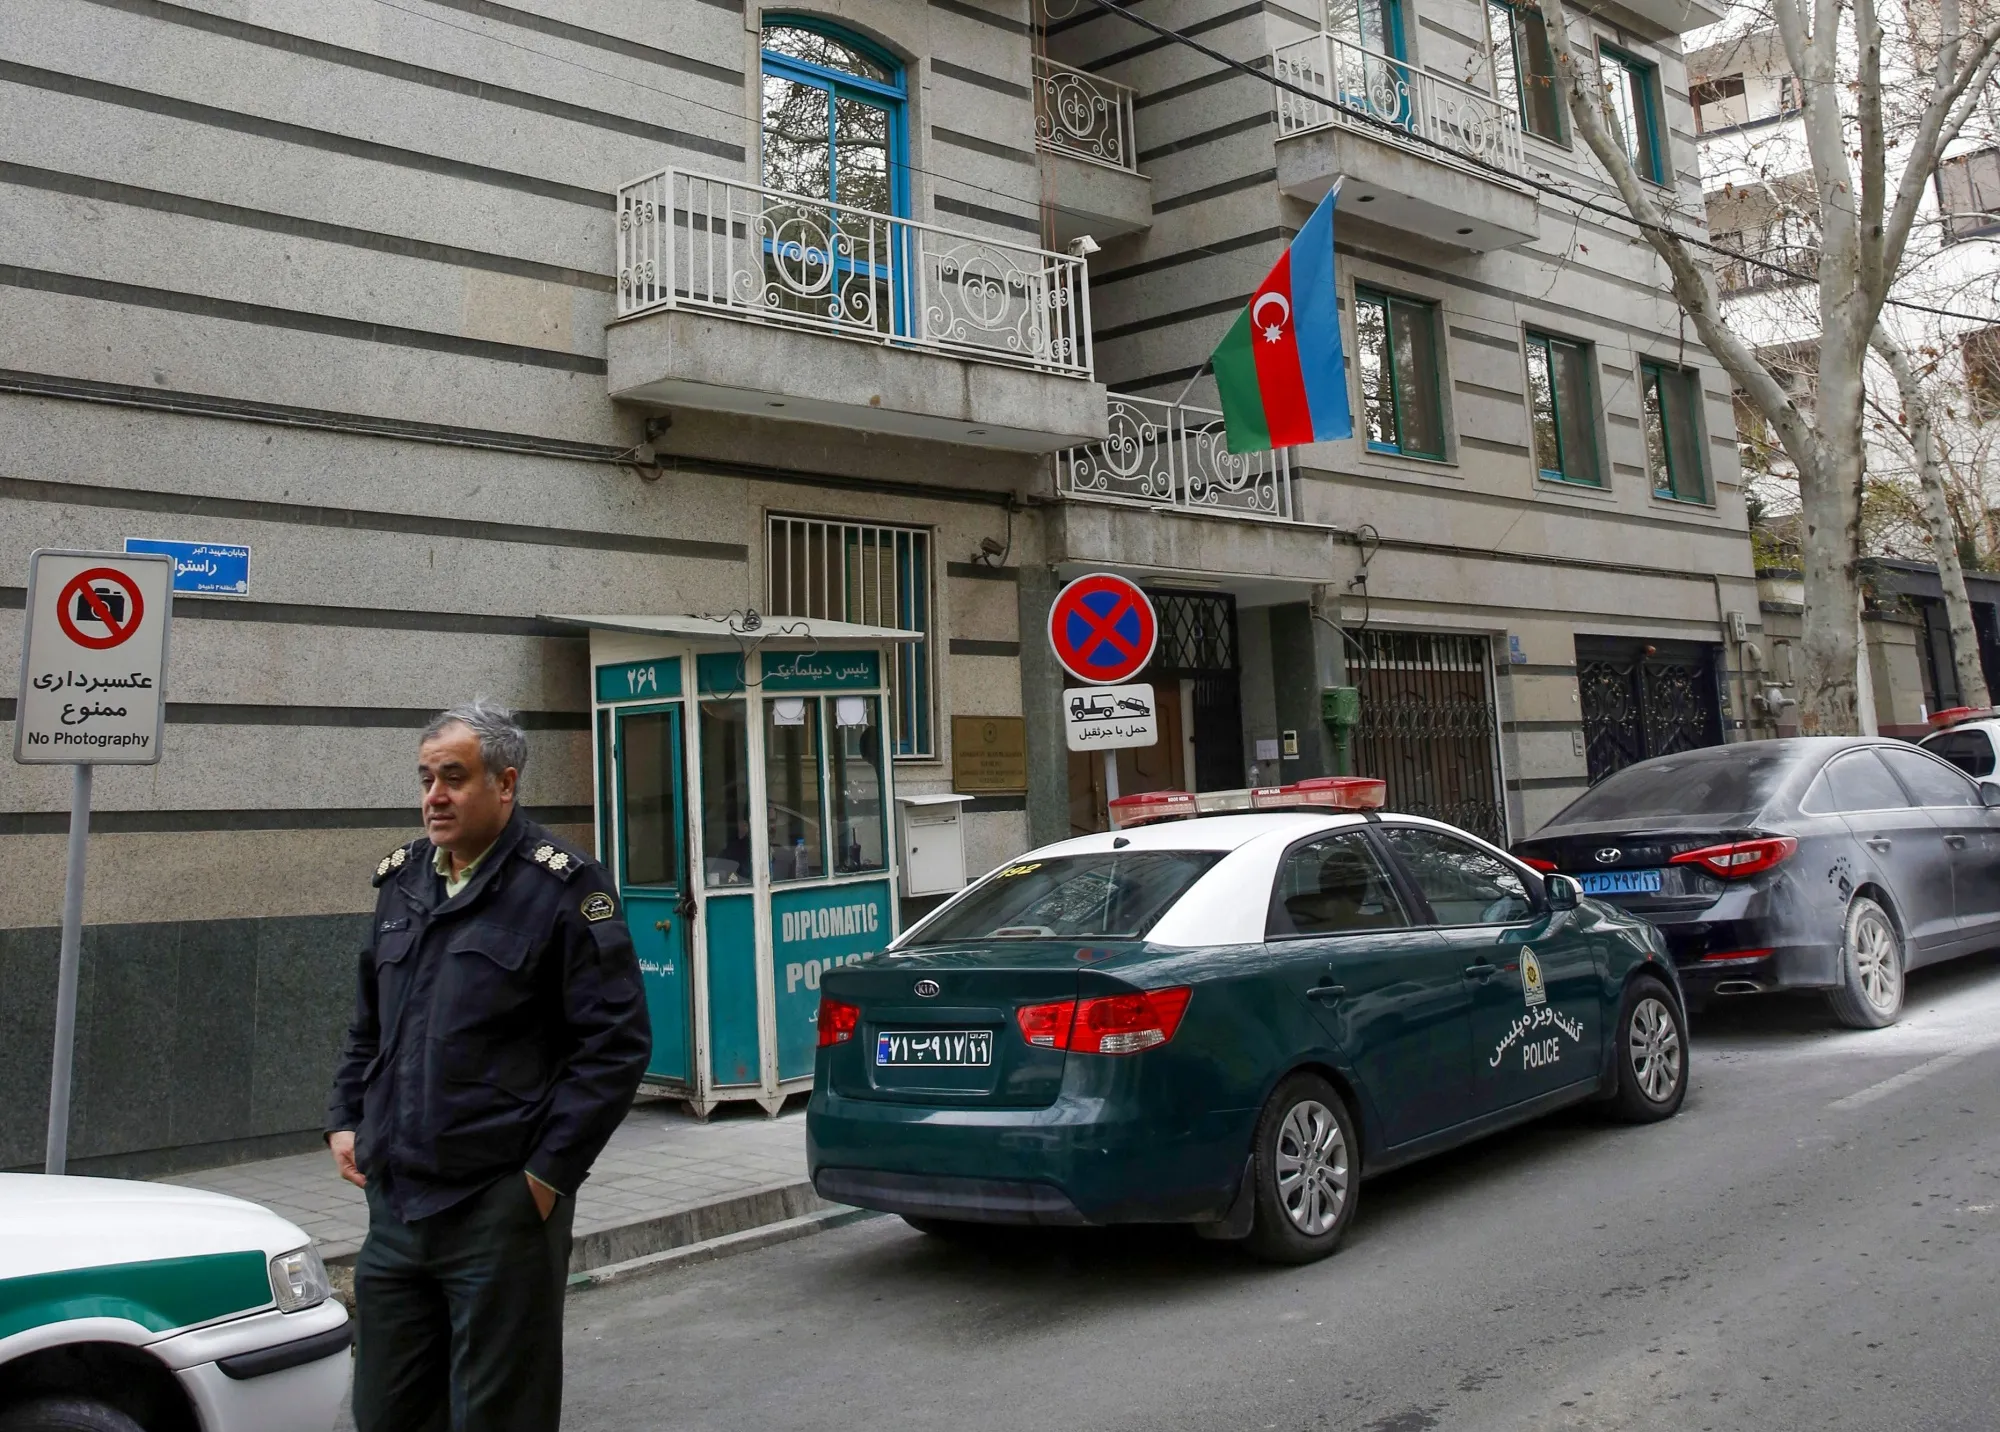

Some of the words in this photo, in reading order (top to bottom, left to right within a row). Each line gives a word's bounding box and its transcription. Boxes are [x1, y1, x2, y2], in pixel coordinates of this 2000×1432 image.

[192, 546, 207, 555] اکبر
[208, 548, 227, 557] شهید
[227, 549, 247, 558] خیابان
[174, 557, 217, 576] راستوا
[835, 662, 869, 679] پلیس
[33, 670, 153, 693] عکسبرداری
[627, 666, 657, 694] ۲۶۹
[60, 702, 127, 725] ممنوع
[28, 731, 50, 745] No
[54, 731, 150, 748] Photography
[1079, 726, 1113, 741] جرثقیل
[1115, 725, 1123, 738] با
[1125, 724, 1148, 738] حمل
[782, 902, 879, 942] DIPLOMATIC
[918, 984, 936, 994] KIA
[1522, 1005, 1553, 1030] ویژه
[1553, 1011, 1584, 1042] گشت
[1489, 1019, 1525, 1068] پلیس
[1523, 1036, 1560, 1070] POLICE
